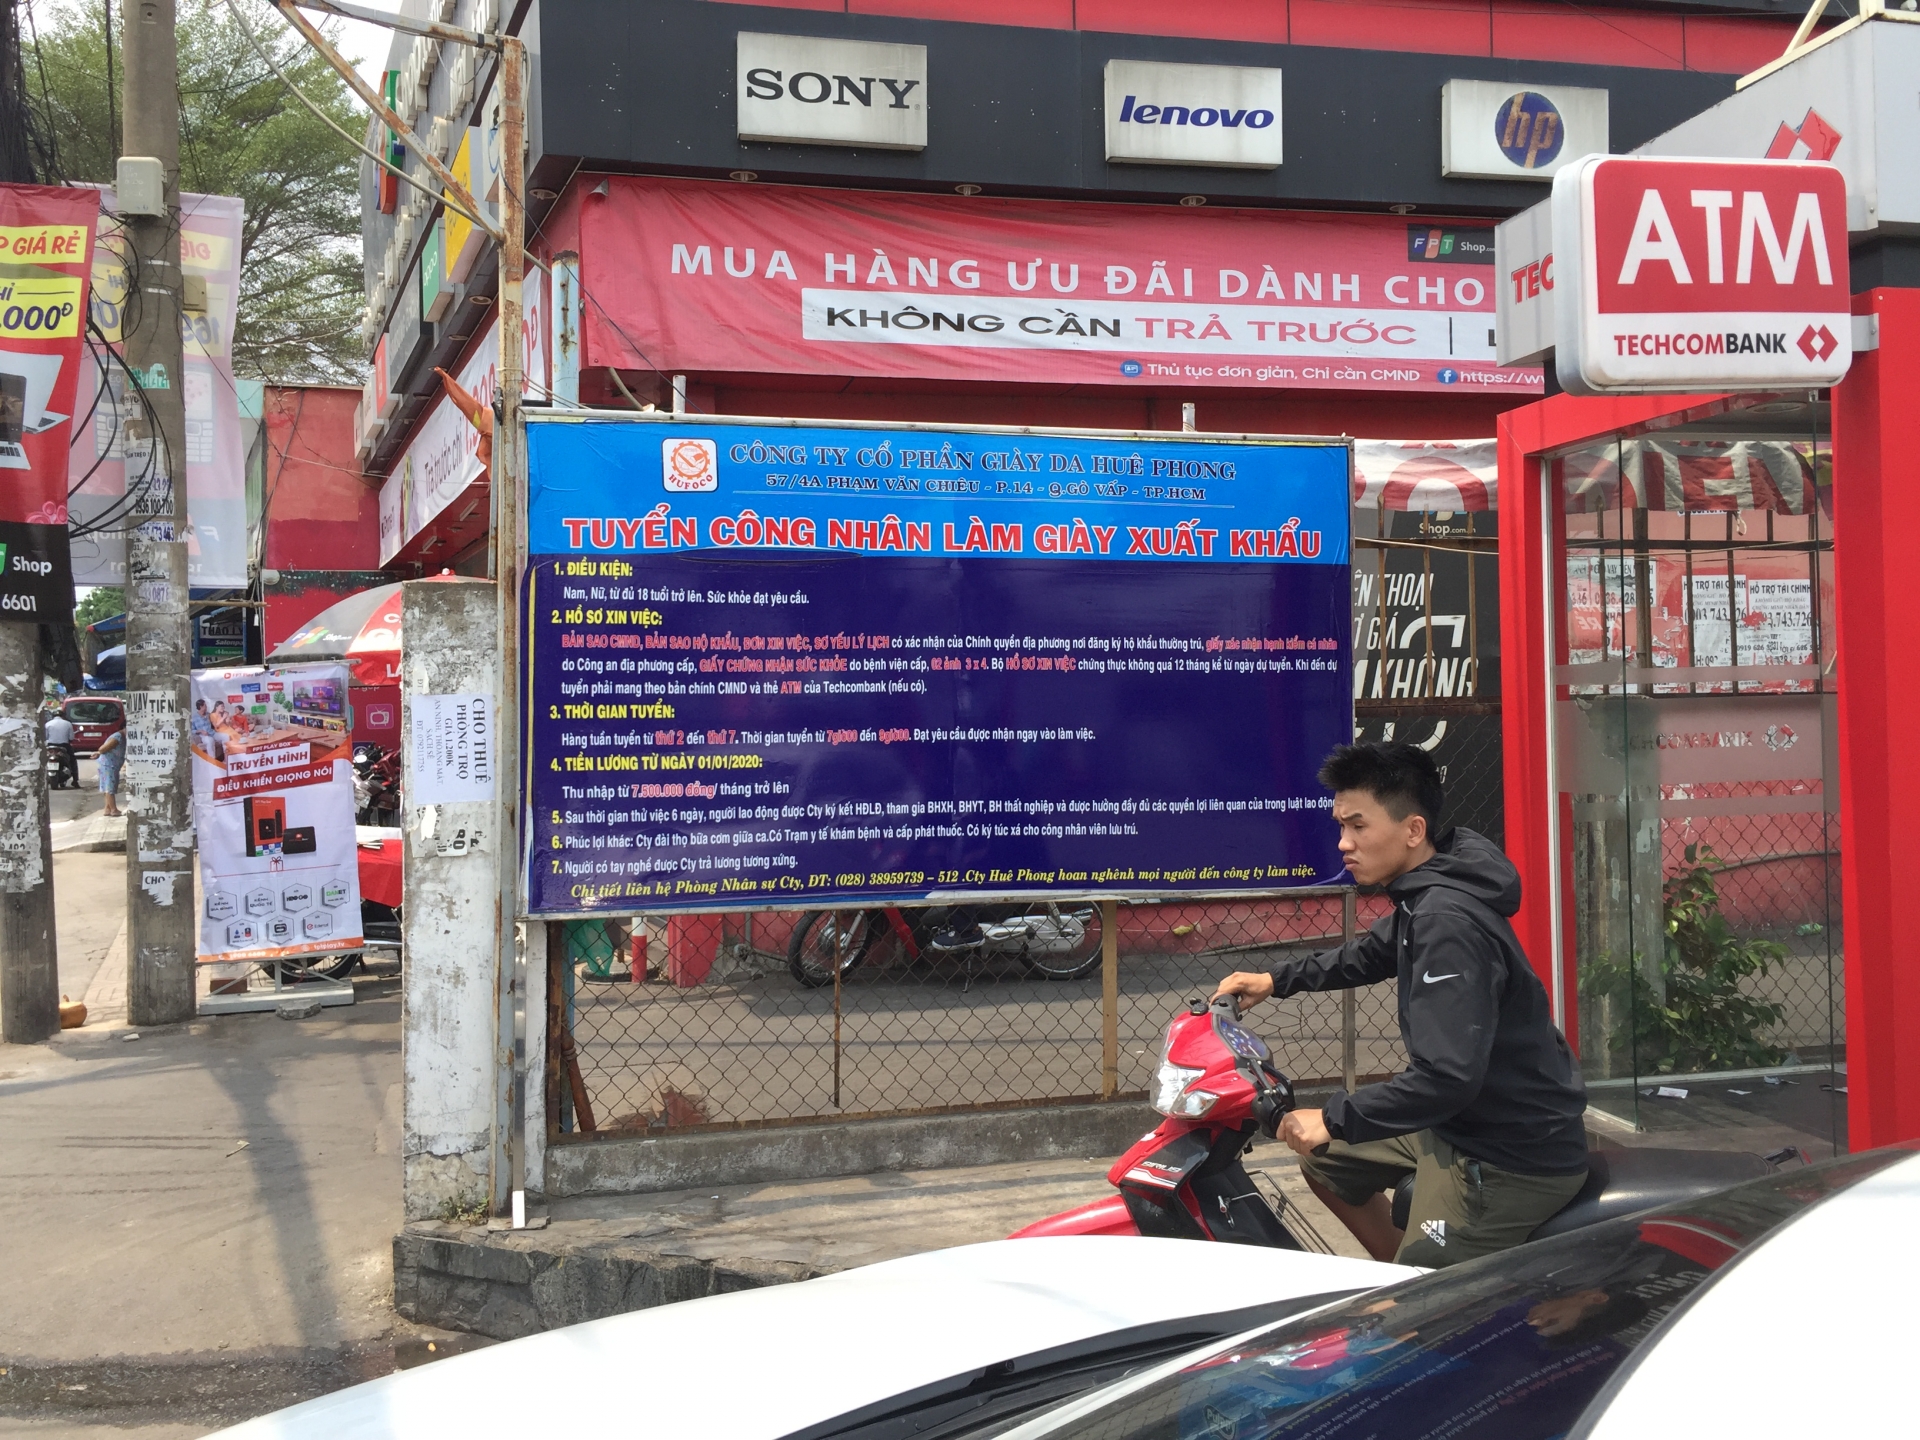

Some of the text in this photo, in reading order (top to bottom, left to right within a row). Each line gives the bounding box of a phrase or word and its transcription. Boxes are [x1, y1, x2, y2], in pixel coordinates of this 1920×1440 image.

[747, 68, 919, 109] SONY
[1119, 95, 1274, 129] lenovo
[1501, 91, 1556, 170] hp
[13, 230, 80, 255] GIÁ RẺ
[1414, 237, 1453, 250] FPT
[1617, 188, 1834, 286] ATM
[671, 243, 1485, 306] MUA HÀNG ƯU ĐÃI DÀNH CHO
[827, 305, 1417, 345] KHÔNG CẦN TRẢ TRƯỚC
[1614, 333, 1788, 356] TECHCOMBANK
[1147, 363, 1420, 382] Thủ tục đơn giản, Chỉ cần CMND
[728, 439, 1237, 481] CÔNG TY CỔ PHẦN GIÀY DA HUÊ PHONG
[668, 474, 713, 490] HUFOCO
[765, 473, 824, 490] 57/4A
[825, 475, 880, 492] PHẠM
[882, 475, 921, 492] VĂN
[924, 476, 981, 494] CHIÊU
[995, 480, 1034, 495] P.14
[1093, 479, 1129, 498] VẤP
[1141, 485, 1207, 501] TP.HCM
[561, 503, 1322, 559] TUYỂN CÔNG NHÂN LÀM GIÀY XUẤT KHẨU
[13, 555, 52, 577] Shop
[553, 555, 633, 581] 1. ĐIỀU KIỆN:
[563, 585, 810, 607] Nam, Nữ, từ đủ 18 tuổi trở lên. Sức khỏe đạt yêu cầu.
[1750, 581, 1811, 595] HỖ TRỢ TÀI CHÍNH
[2, 593, 37, 612] 6601
[551, 605, 663, 629] 2. HỒ SƠ XIN VIỆC:
[549, 697, 675, 720] 3. THỜI GIAN TUYỂN:
[444, 718, 453, 736] GIÁ
[456, 704, 469, 780] PHÒNG TRỌ
[472, 698, 492, 784] CHO THUÊ
[230, 751, 308, 771] TRUYỀN HÌNH
[550, 757, 562, 772] 4.
[596, 753, 639, 771] LƯƠNG
[640, 752, 660, 771] TỪ
[660, 752, 696, 770] NGÀY
[697, 754, 763, 771] 01/01/2020:
[217, 766, 332, 793] ĐIỀU KHIỂN GIỌNG NÓI
[1420, 1222, 1447, 1247] adidas
